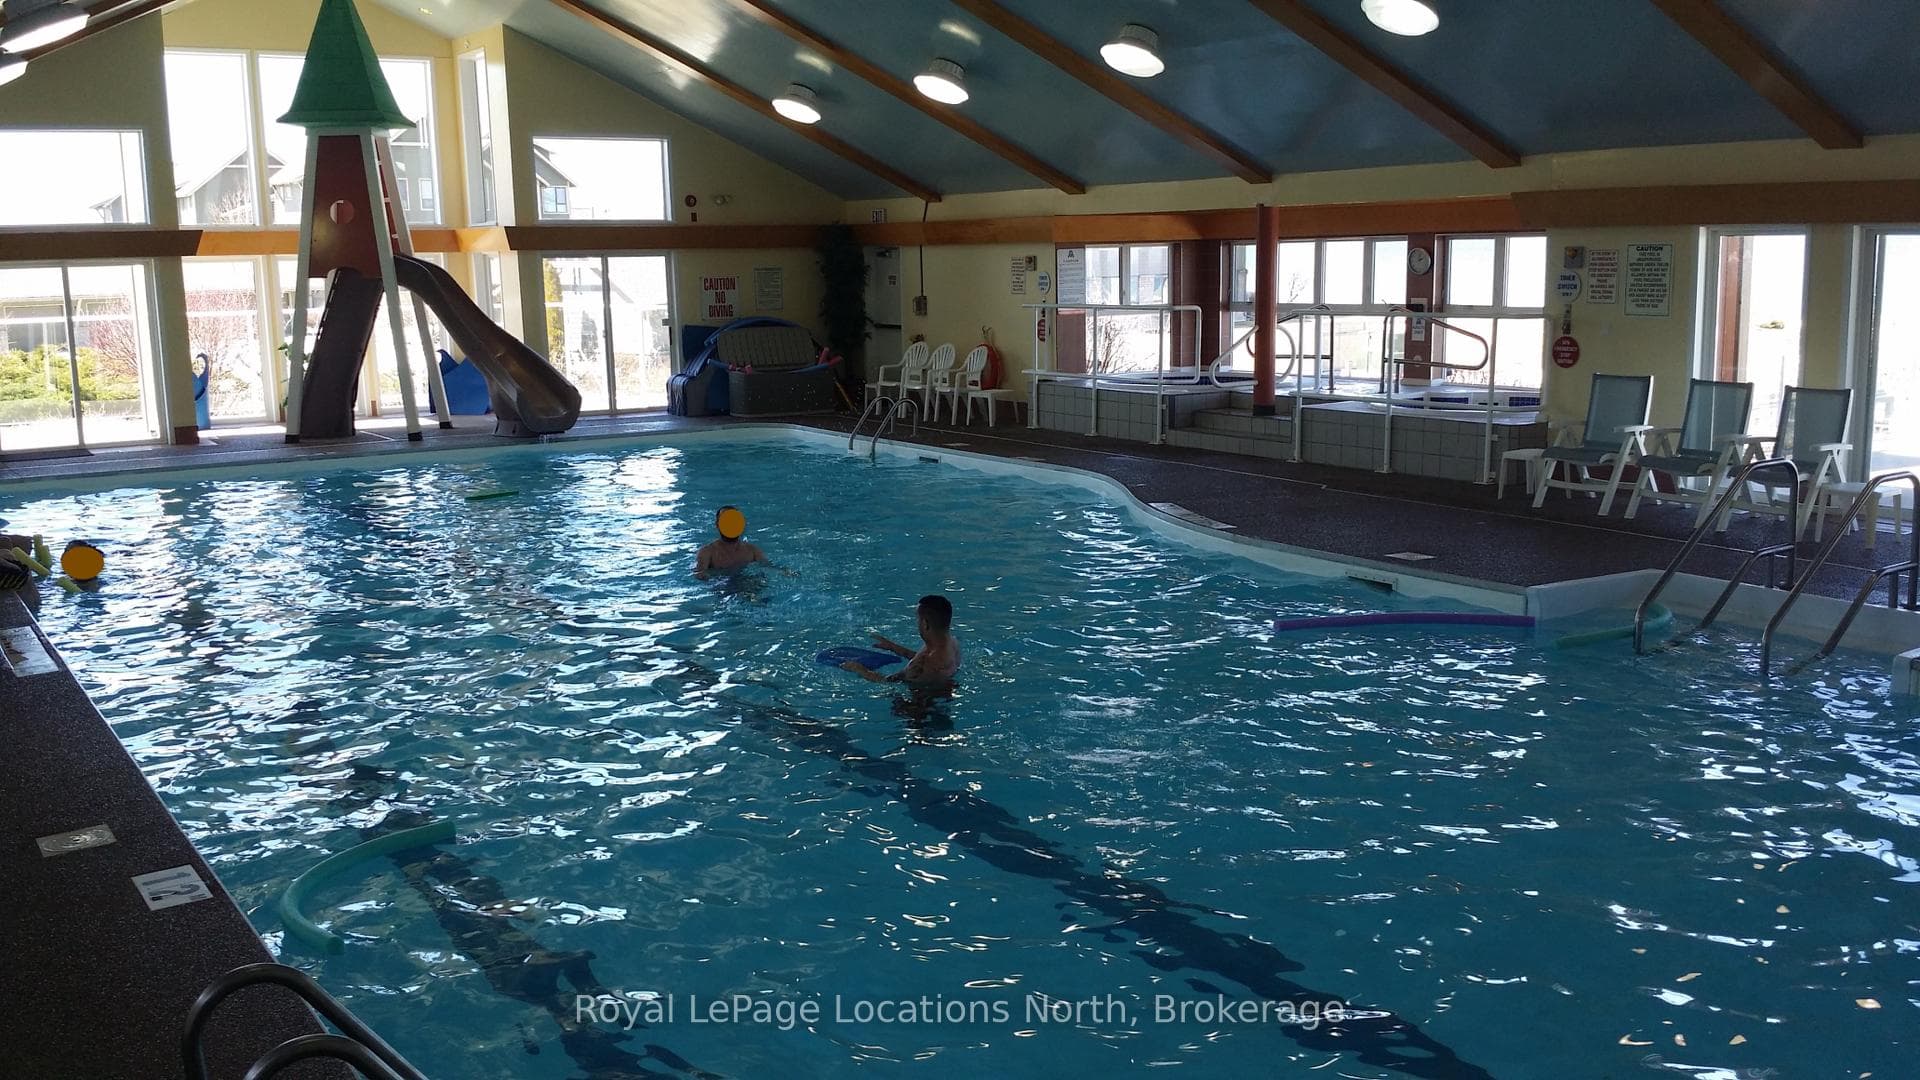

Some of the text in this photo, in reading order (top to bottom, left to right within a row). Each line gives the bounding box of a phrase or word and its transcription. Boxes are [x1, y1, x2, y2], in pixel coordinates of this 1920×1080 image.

[703, 277, 736, 291] CAUTION
[714, 291, 726, 304] NO
[708, 304, 734, 318] DIVING
